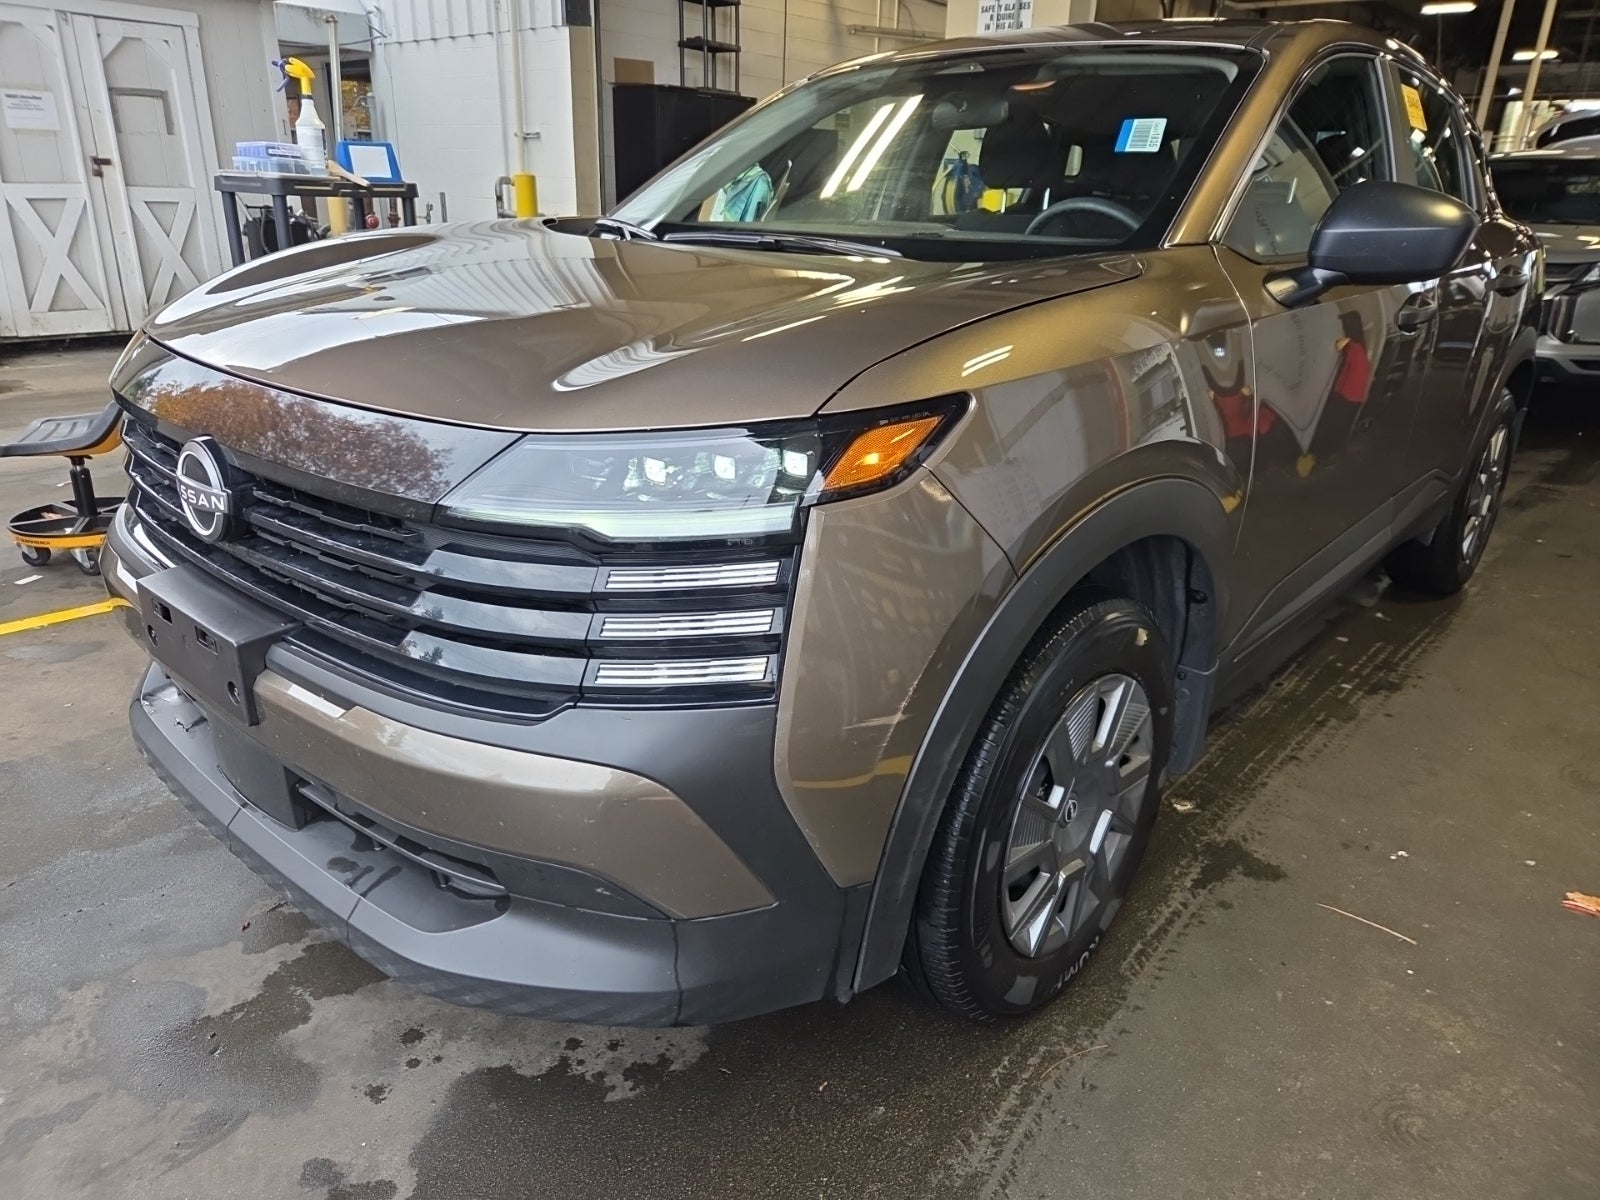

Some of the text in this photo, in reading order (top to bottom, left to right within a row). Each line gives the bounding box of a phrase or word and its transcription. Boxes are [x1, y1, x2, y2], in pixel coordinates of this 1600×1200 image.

[981, 2, 1031, 13] SAFEY GLASES
[990, 12, 1019, 21] RQUIRE
[992, 21, 1006, 31] HIS
[180, 484, 225, 511] SSAN
